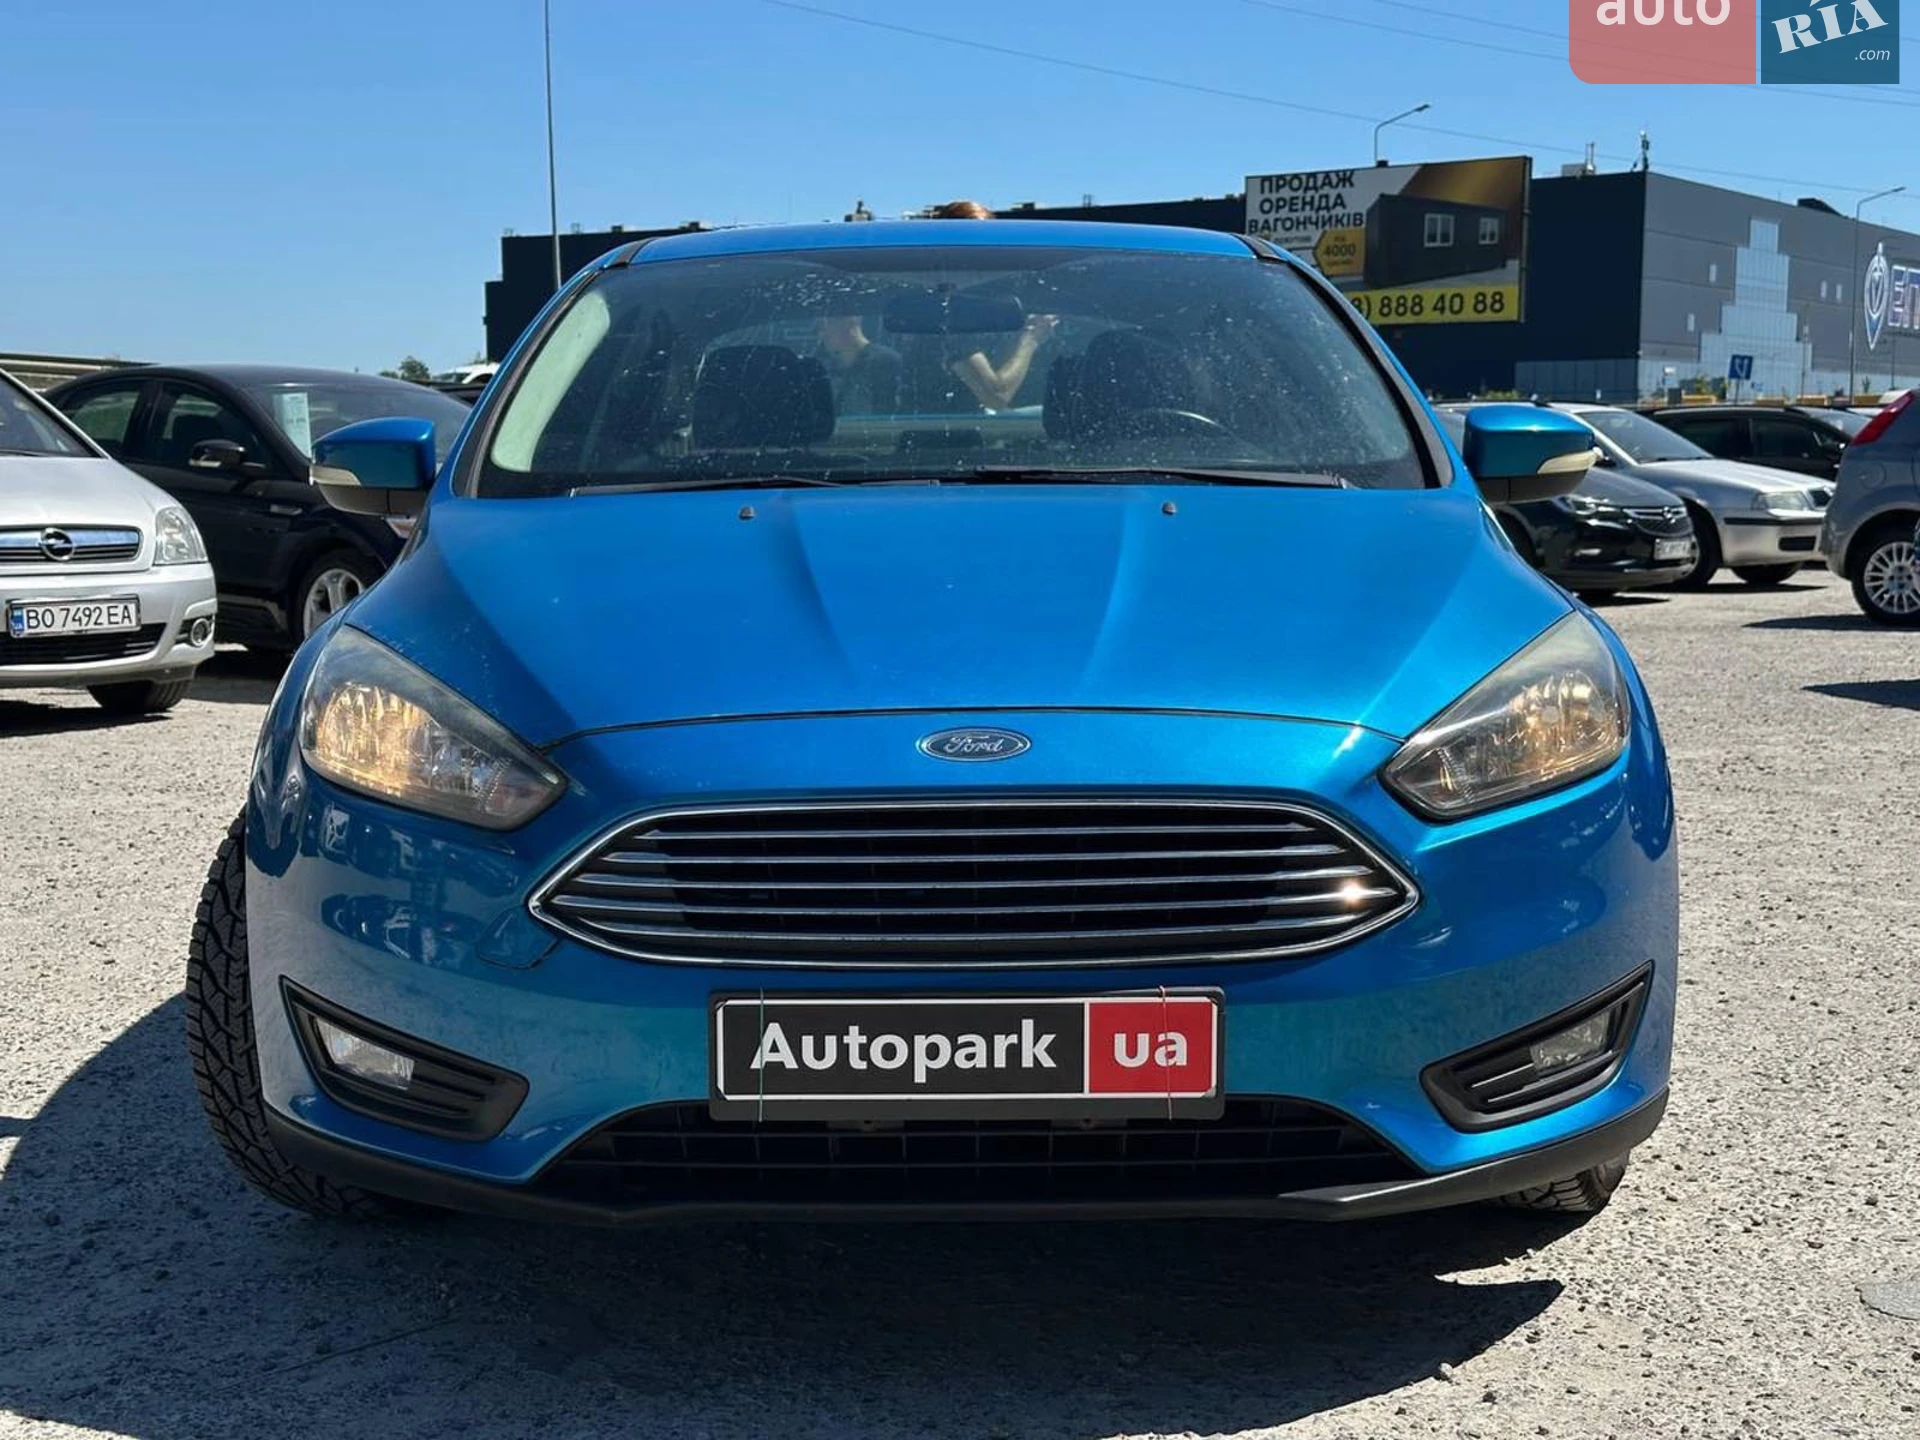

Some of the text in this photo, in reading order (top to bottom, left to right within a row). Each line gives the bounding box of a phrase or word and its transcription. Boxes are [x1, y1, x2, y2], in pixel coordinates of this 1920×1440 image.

[1260, 169, 1355, 194] ПРОДАЖ
[1259, 193, 1347, 215] ОРЕНДА
[1248, 212, 1364, 234] ВАГОНЧИКІВ
[1378, 293, 1424, 317] 888
[1432, 292, 1465, 315] 40
[1472, 291, 1505, 314] 88
[26, 608, 55, 629] BO
[60, 606, 104, 628] 7492
[107, 605, 132, 625] EA
[943, 735, 1004, 753] Ford
[750, 1018, 1188, 1084] Autopark ua
